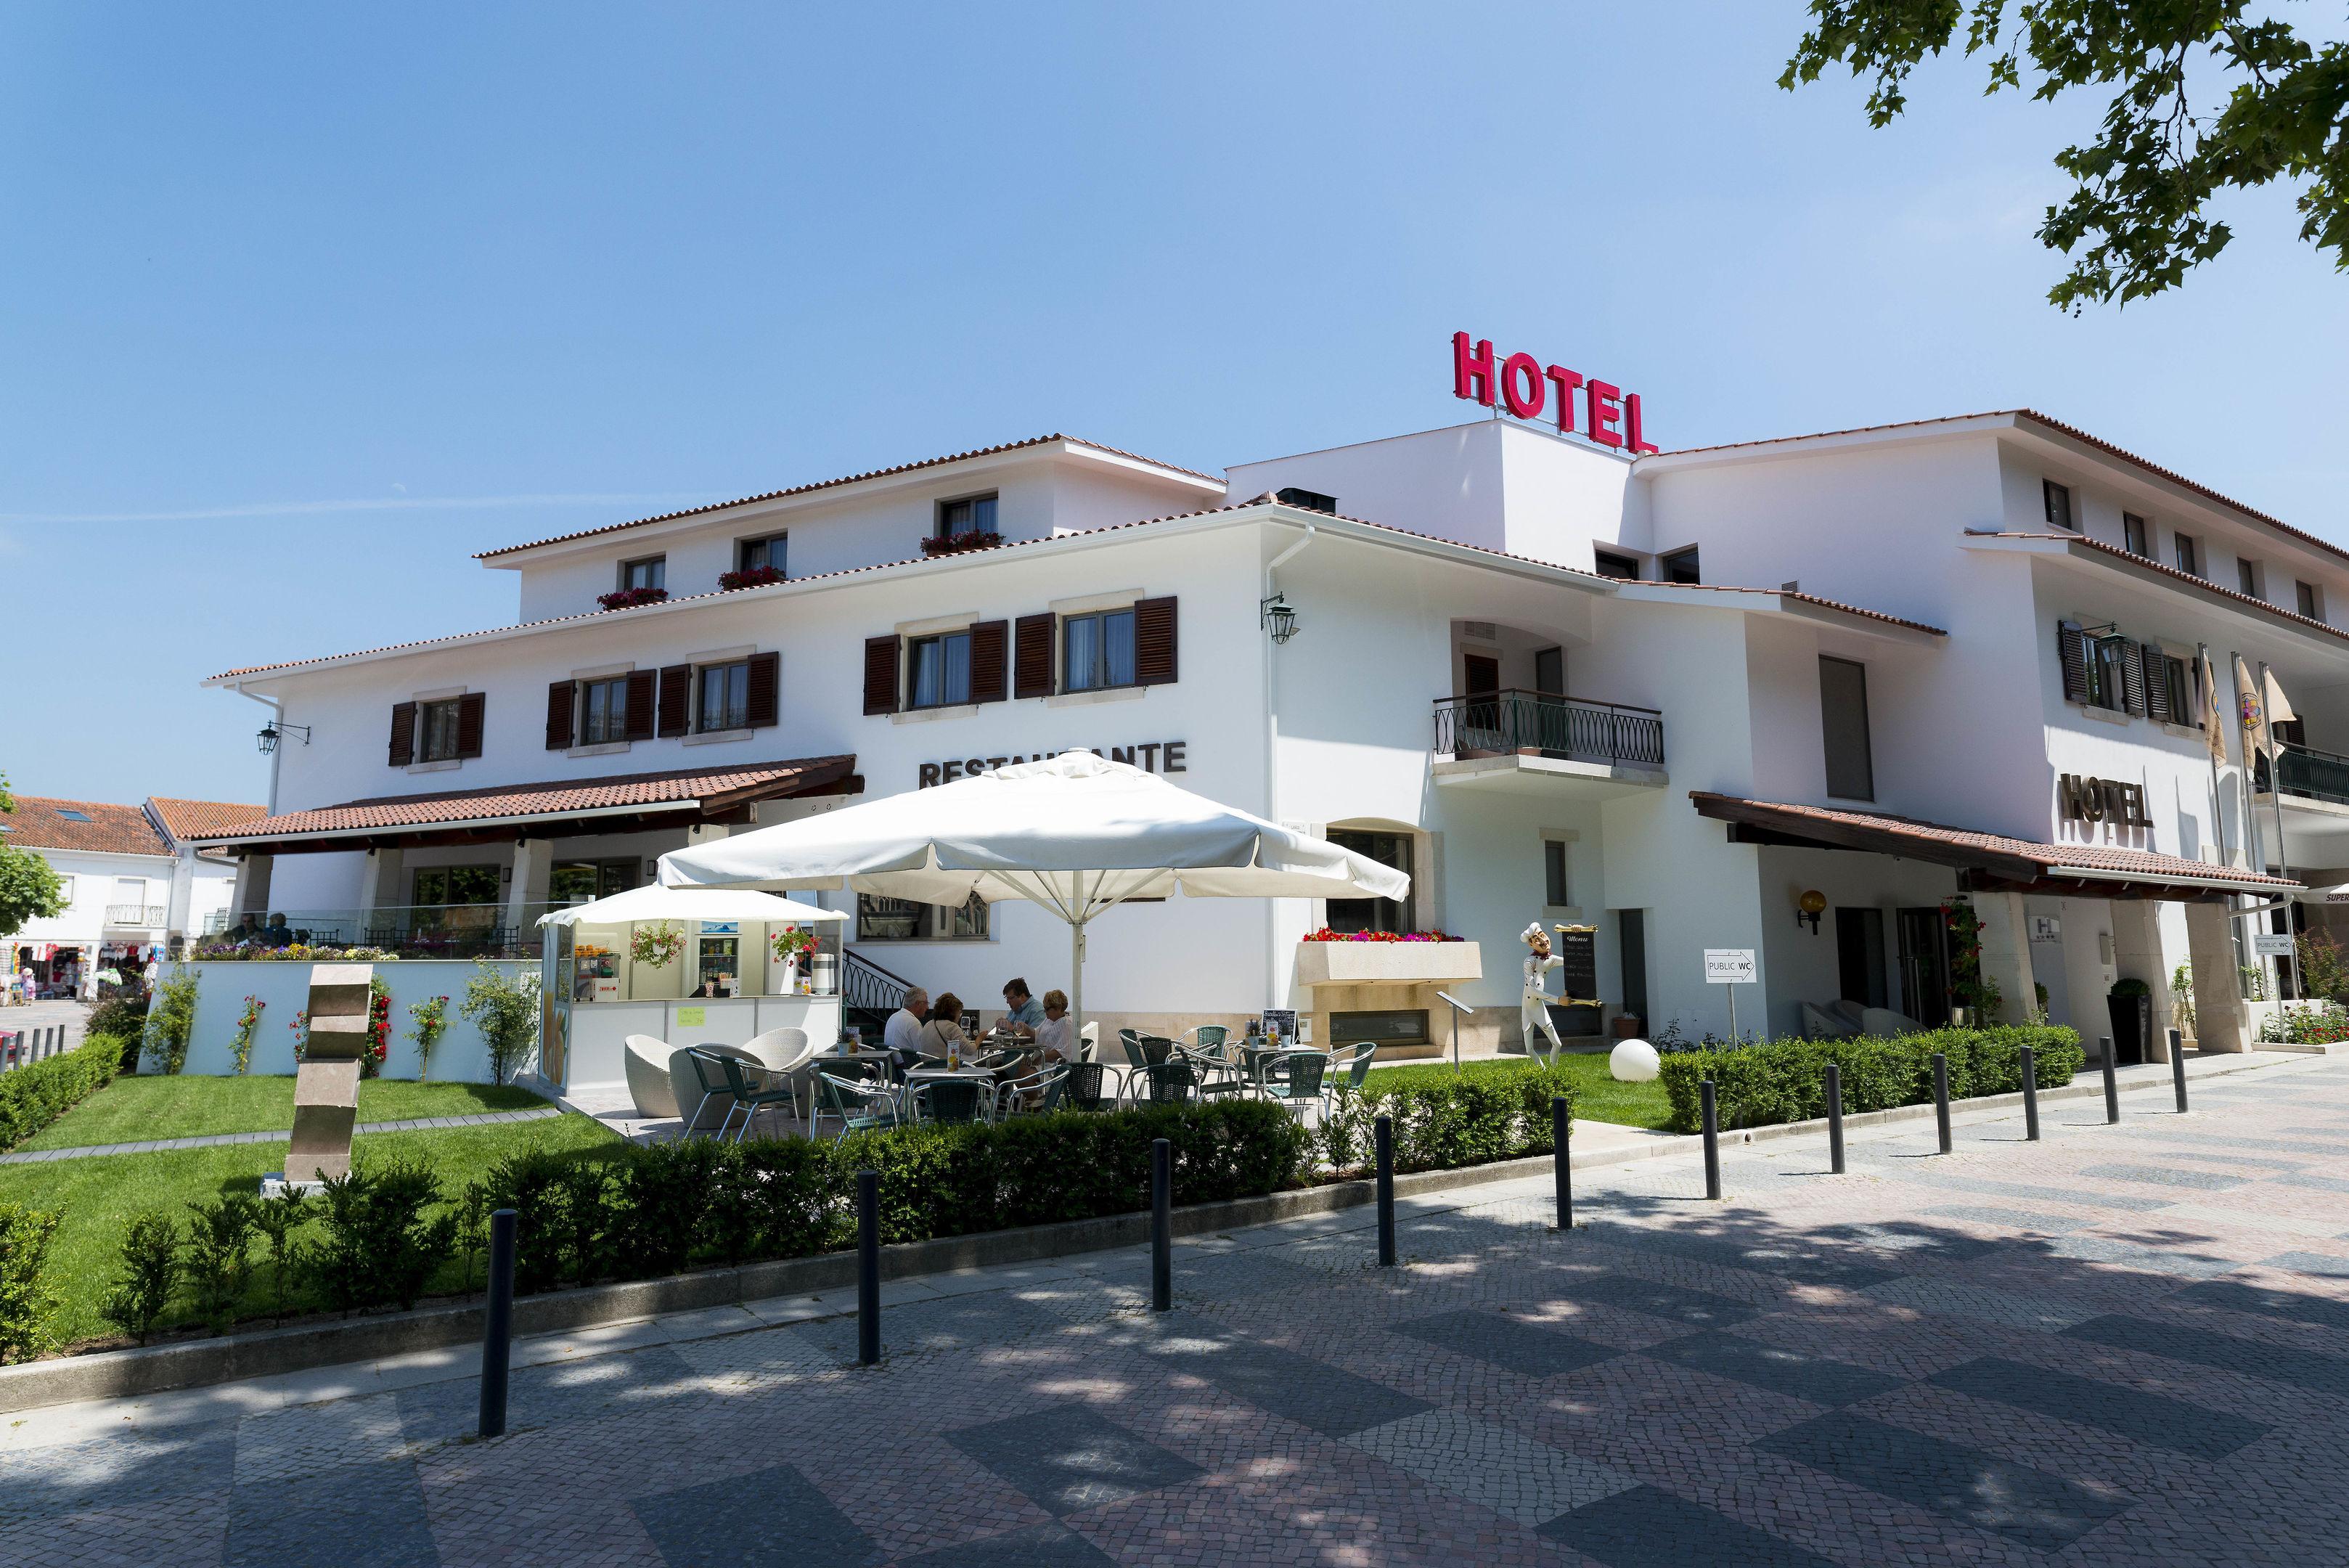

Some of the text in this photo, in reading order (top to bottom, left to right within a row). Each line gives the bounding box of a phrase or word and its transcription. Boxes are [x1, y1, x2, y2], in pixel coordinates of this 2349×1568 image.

[1453, 330, 1659, 454] HOTEL
[2060, 773, 2154, 828] HOTEL
[2038, 918, 2051, 934] H
[1709, 962, 1736, 971] PUBLIC
